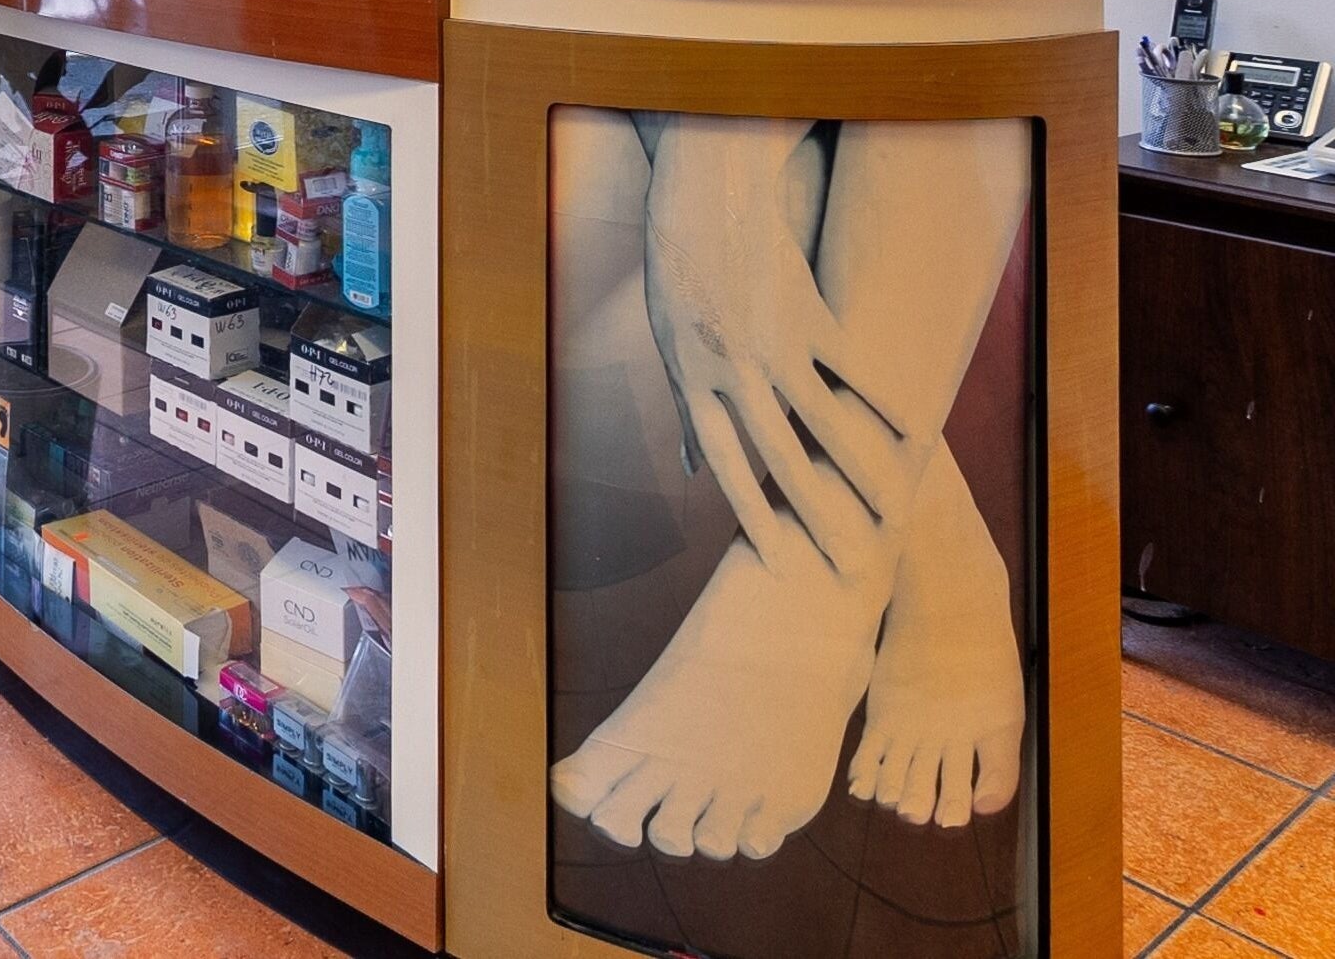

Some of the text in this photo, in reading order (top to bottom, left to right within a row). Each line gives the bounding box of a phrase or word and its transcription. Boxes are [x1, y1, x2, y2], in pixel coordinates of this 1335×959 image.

[299, 559, 334, 579] CND
[283, 599, 316, 623] CND
[276, 718, 301, 739] SIMPLY
[326, 752, 353, 774] SIMPLY
